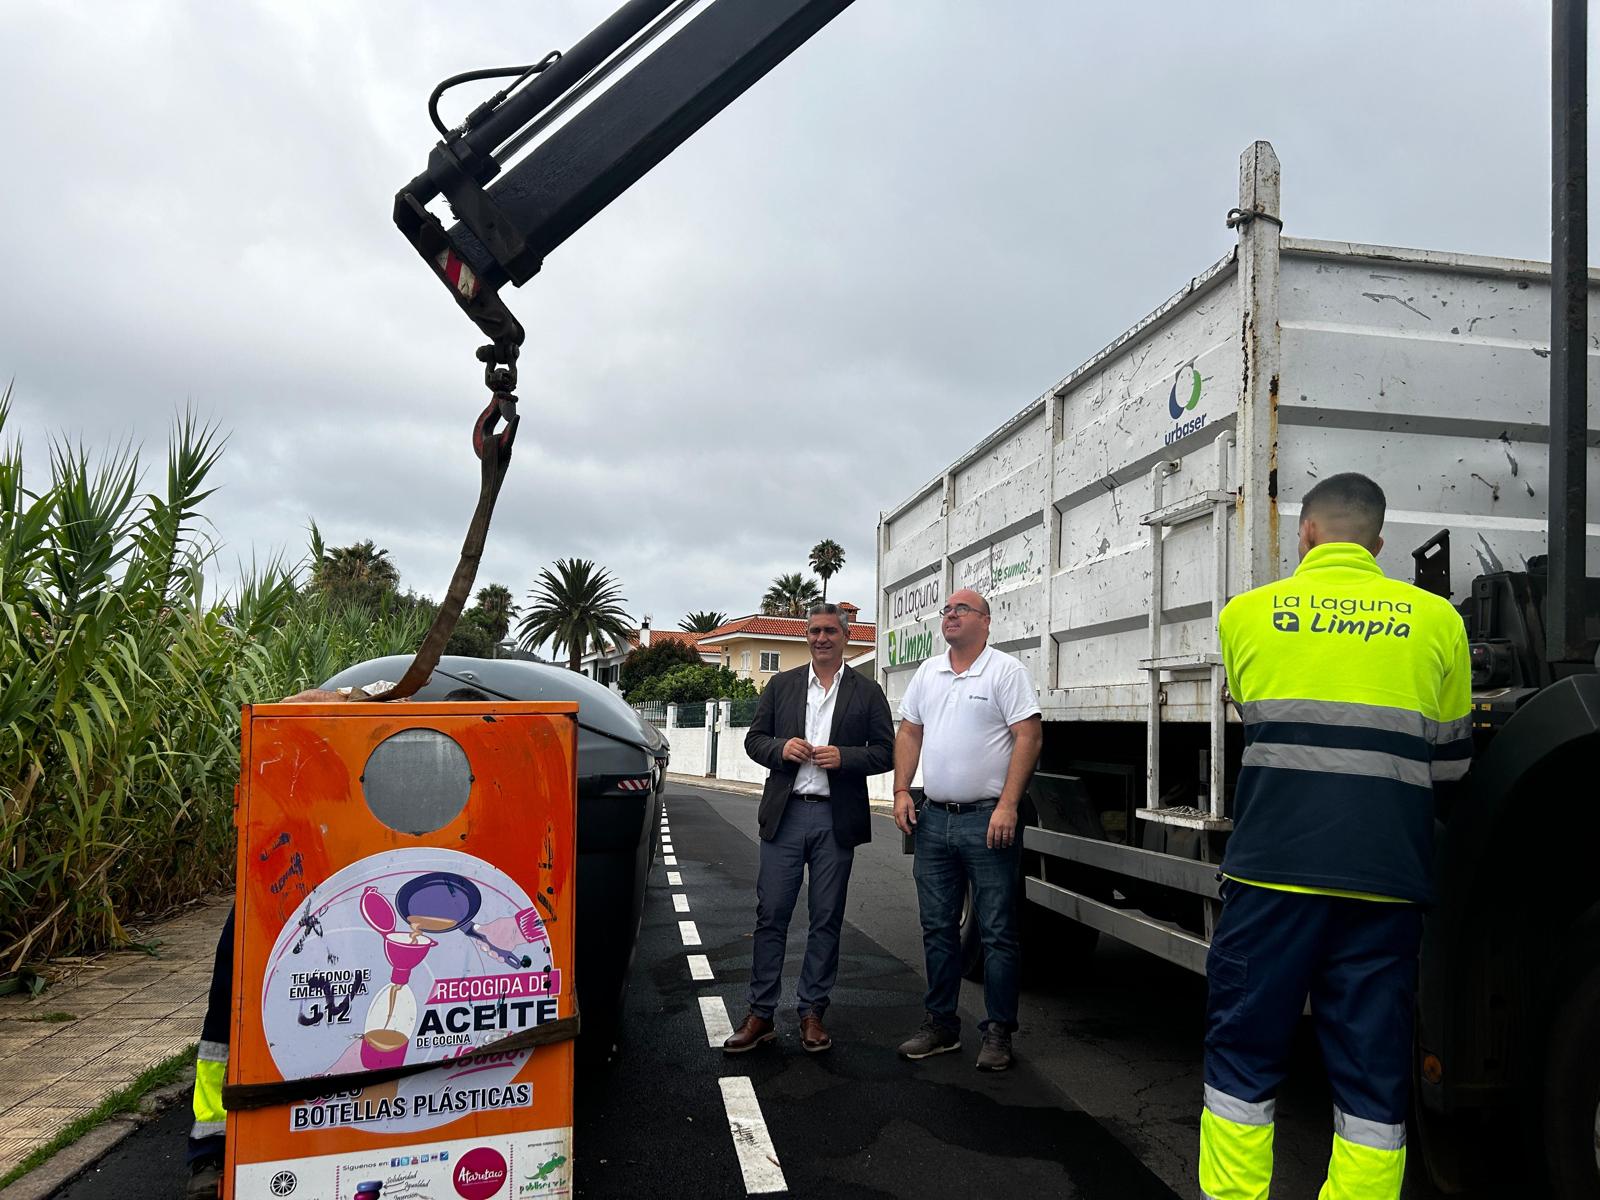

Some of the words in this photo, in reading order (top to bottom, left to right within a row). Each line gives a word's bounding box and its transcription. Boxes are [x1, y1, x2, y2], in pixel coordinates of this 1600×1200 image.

[1164, 413, 1207, 445] urbaser
[893, 589, 903, 619] La
[905, 579, 939, 618] Laguna
[1273, 595, 1300, 609] La
[1310, 595, 1412, 615] Laguna
[899, 622, 933, 662] Limpia
[1310, 612, 1411, 642] Limpia
[289, 983, 367, 998] EMERENCA
[437, 977, 523, 1000] RECOGIDA
[528, 975, 549, 992] DE
[416, 999, 558, 1037] ACEITE
[416, 1037, 430, 1048] DE
[432, 1034, 471, 1046] COCINA
[294, 1098, 406, 1128] BOTELLAS
[414, 1084, 529, 1115] PLÁSTICAS
